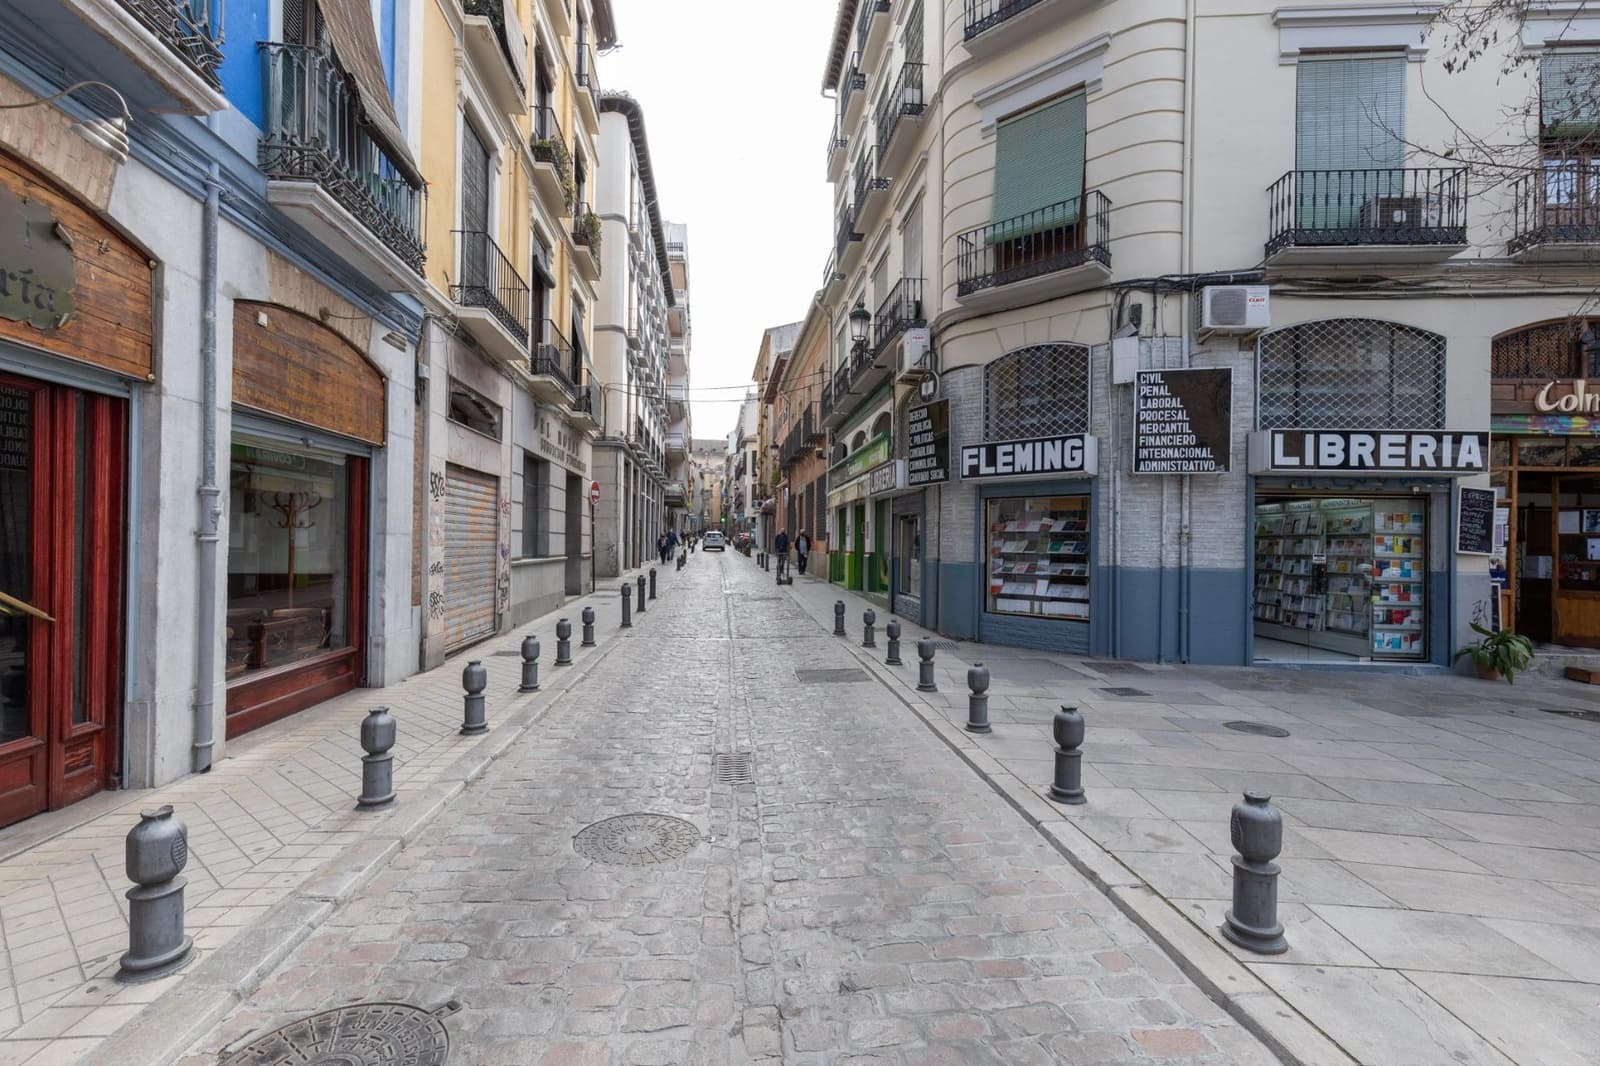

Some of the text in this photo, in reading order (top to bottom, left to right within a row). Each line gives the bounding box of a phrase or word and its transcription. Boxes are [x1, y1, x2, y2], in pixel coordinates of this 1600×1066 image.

[1140, 373, 1165, 384] CIVIL
[1140, 385, 1171, 396] PENAL
[1140, 397, 1184, 409] LABORAL
[1140, 409, 1190, 421] PROCESAL
[1139, 422, 1193, 434] MERCANTIL
[1139, 434, 1196, 446] FINANCIERO
[1139, 447, 1214, 459] INTERNACIONAL
[1273, 433, 1483, 468] LIBRERIA
[962, 438, 1083, 476] FLEMING
[1139, 460, 1216, 472] ADMINISTRATIVO
[870, 463, 896, 493] LIBRERIA
